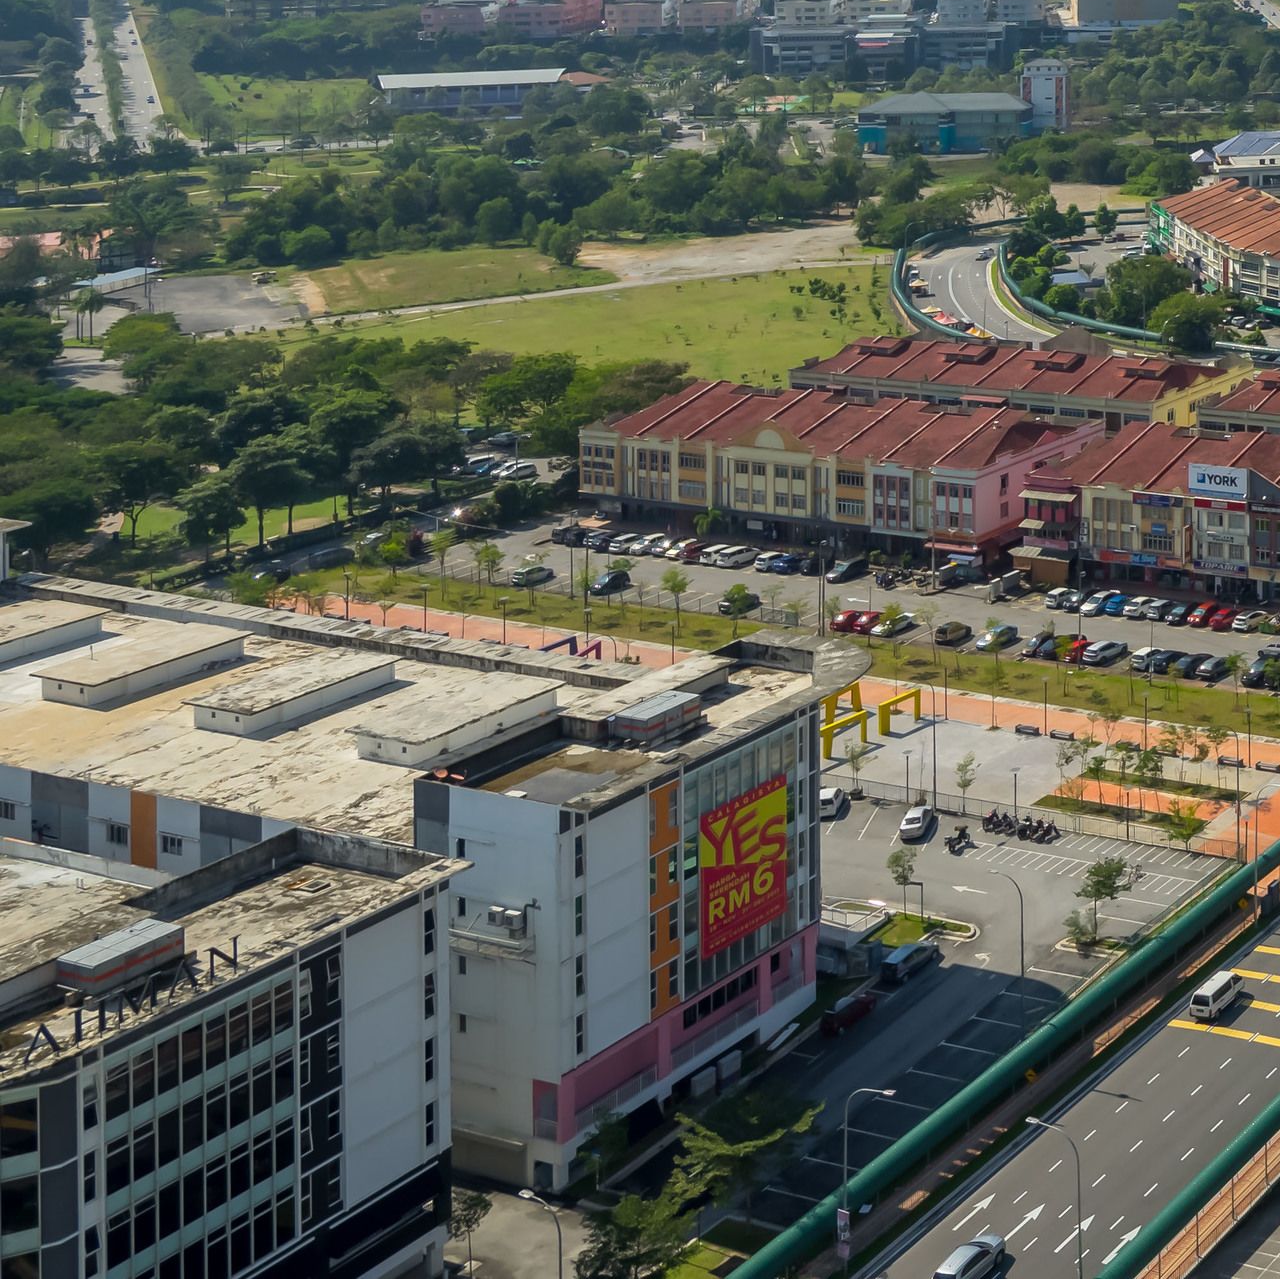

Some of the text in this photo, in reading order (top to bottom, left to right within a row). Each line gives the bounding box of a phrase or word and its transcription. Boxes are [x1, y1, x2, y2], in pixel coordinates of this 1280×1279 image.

[1207, 473, 1238, 487] YORK
[701, 808, 787, 868] YES
[709, 871, 736, 891] HARGA
[709, 872, 750, 899] SERENDAH
[0, 933, 241, 1072] AHMAN
